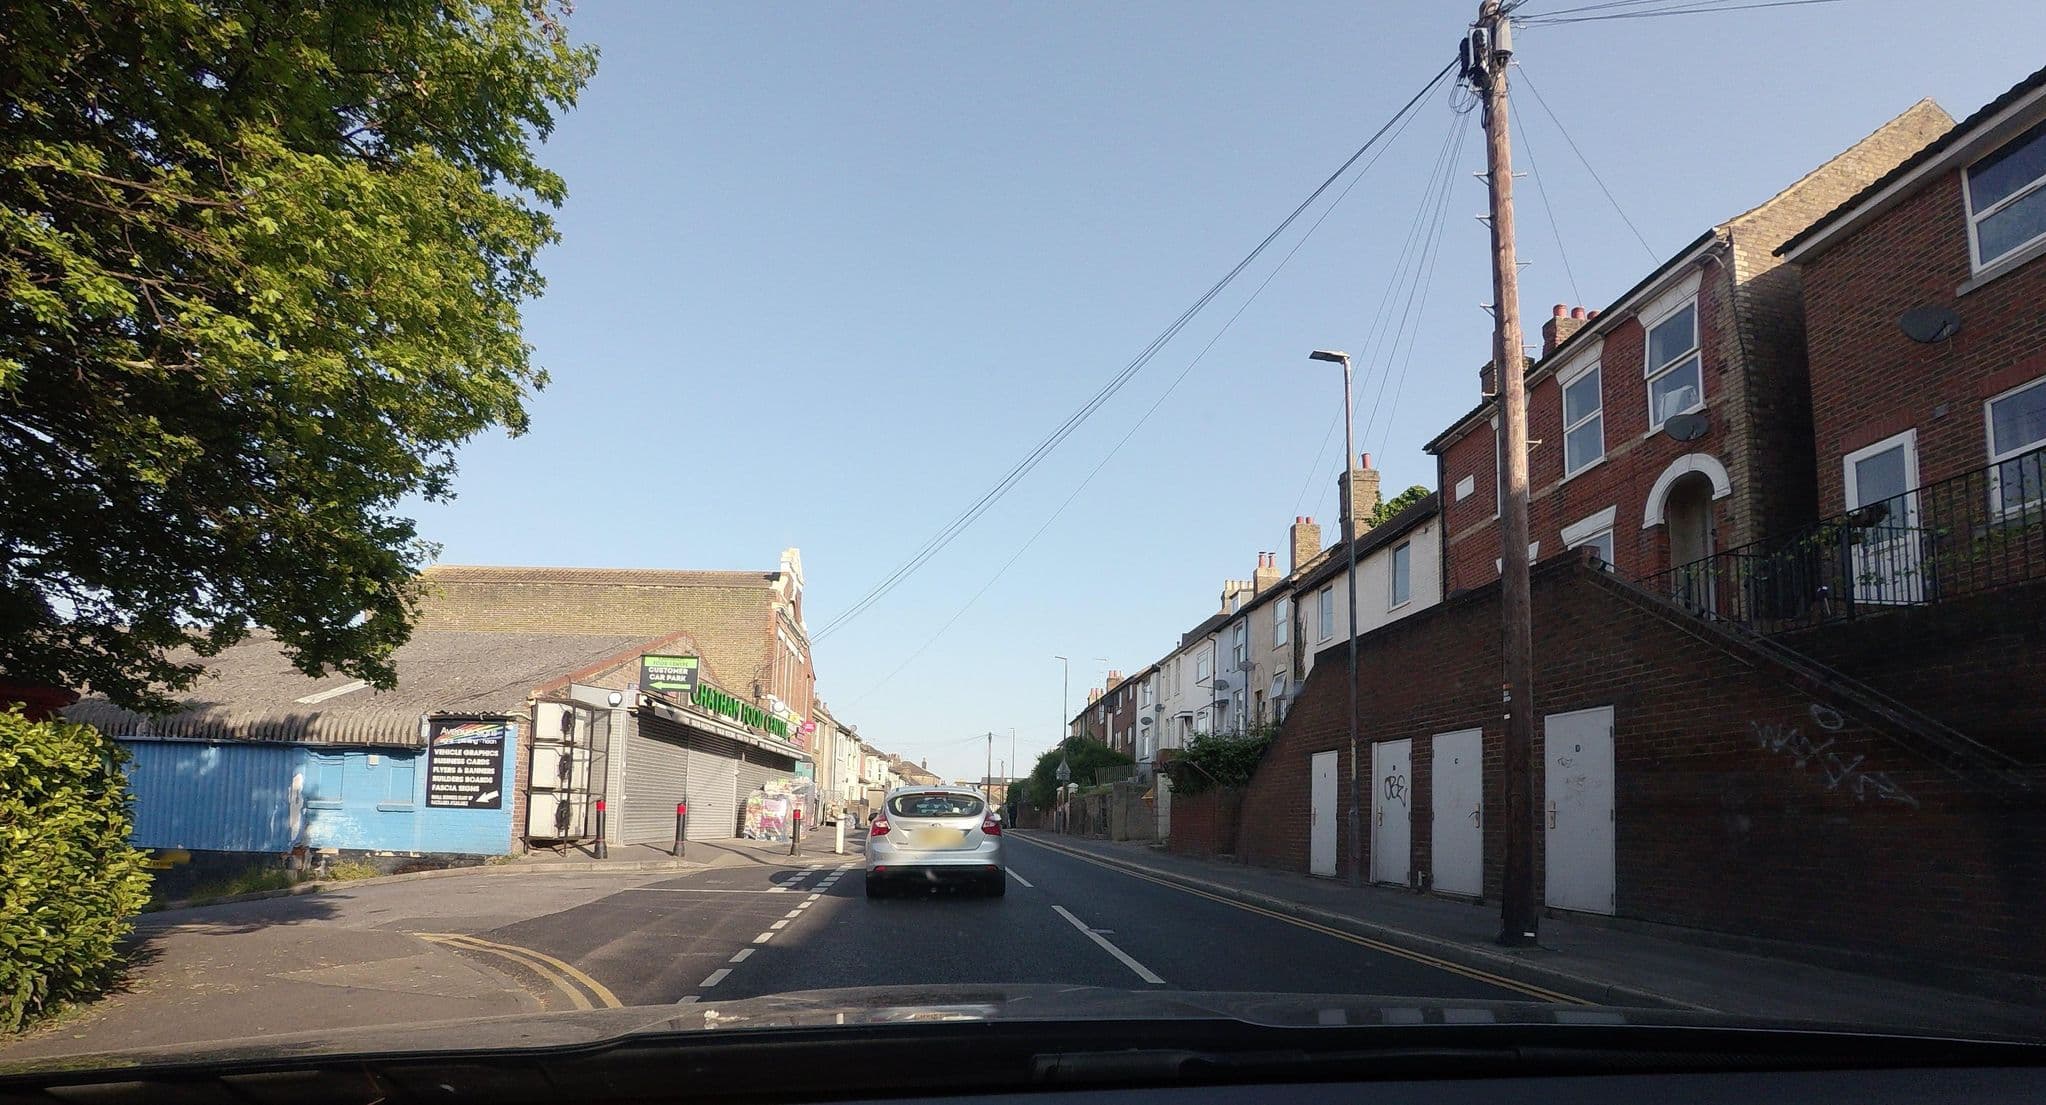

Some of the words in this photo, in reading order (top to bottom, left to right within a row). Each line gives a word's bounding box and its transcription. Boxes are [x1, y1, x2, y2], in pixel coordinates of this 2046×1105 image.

[648, 666, 689, 675] CUSTOMER
[649, 673, 666, 681] CAR
[666, 674, 687, 682] PARK
[741, 703, 765, 730] FOOD
[433, 748, 463, 756] VEHICLE
[463, 749, 499, 757] GRAPHICS
[433, 757, 465, 765] BUSINESS
[432, 775, 464, 783] BUILDERS
